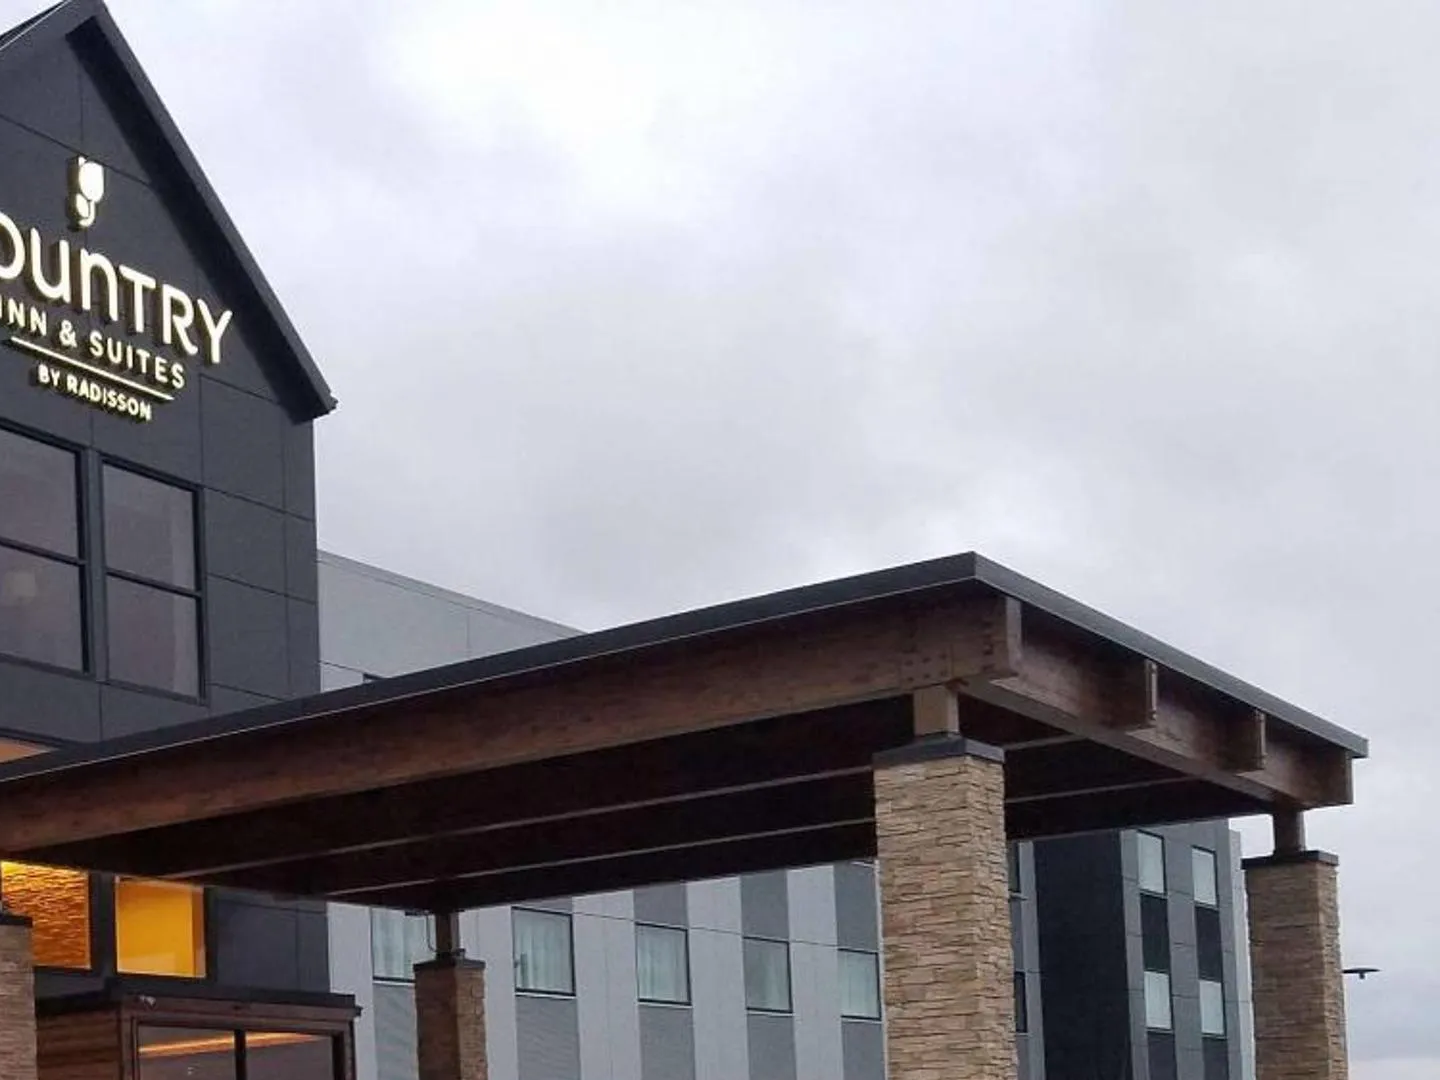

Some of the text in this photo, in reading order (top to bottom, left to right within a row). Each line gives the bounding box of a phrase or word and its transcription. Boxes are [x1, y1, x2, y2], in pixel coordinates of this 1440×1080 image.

[58, 320, 78, 349] &
[89, 330, 185, 390] SUITES
[36, 363, 152, 421] BY RADISSON
